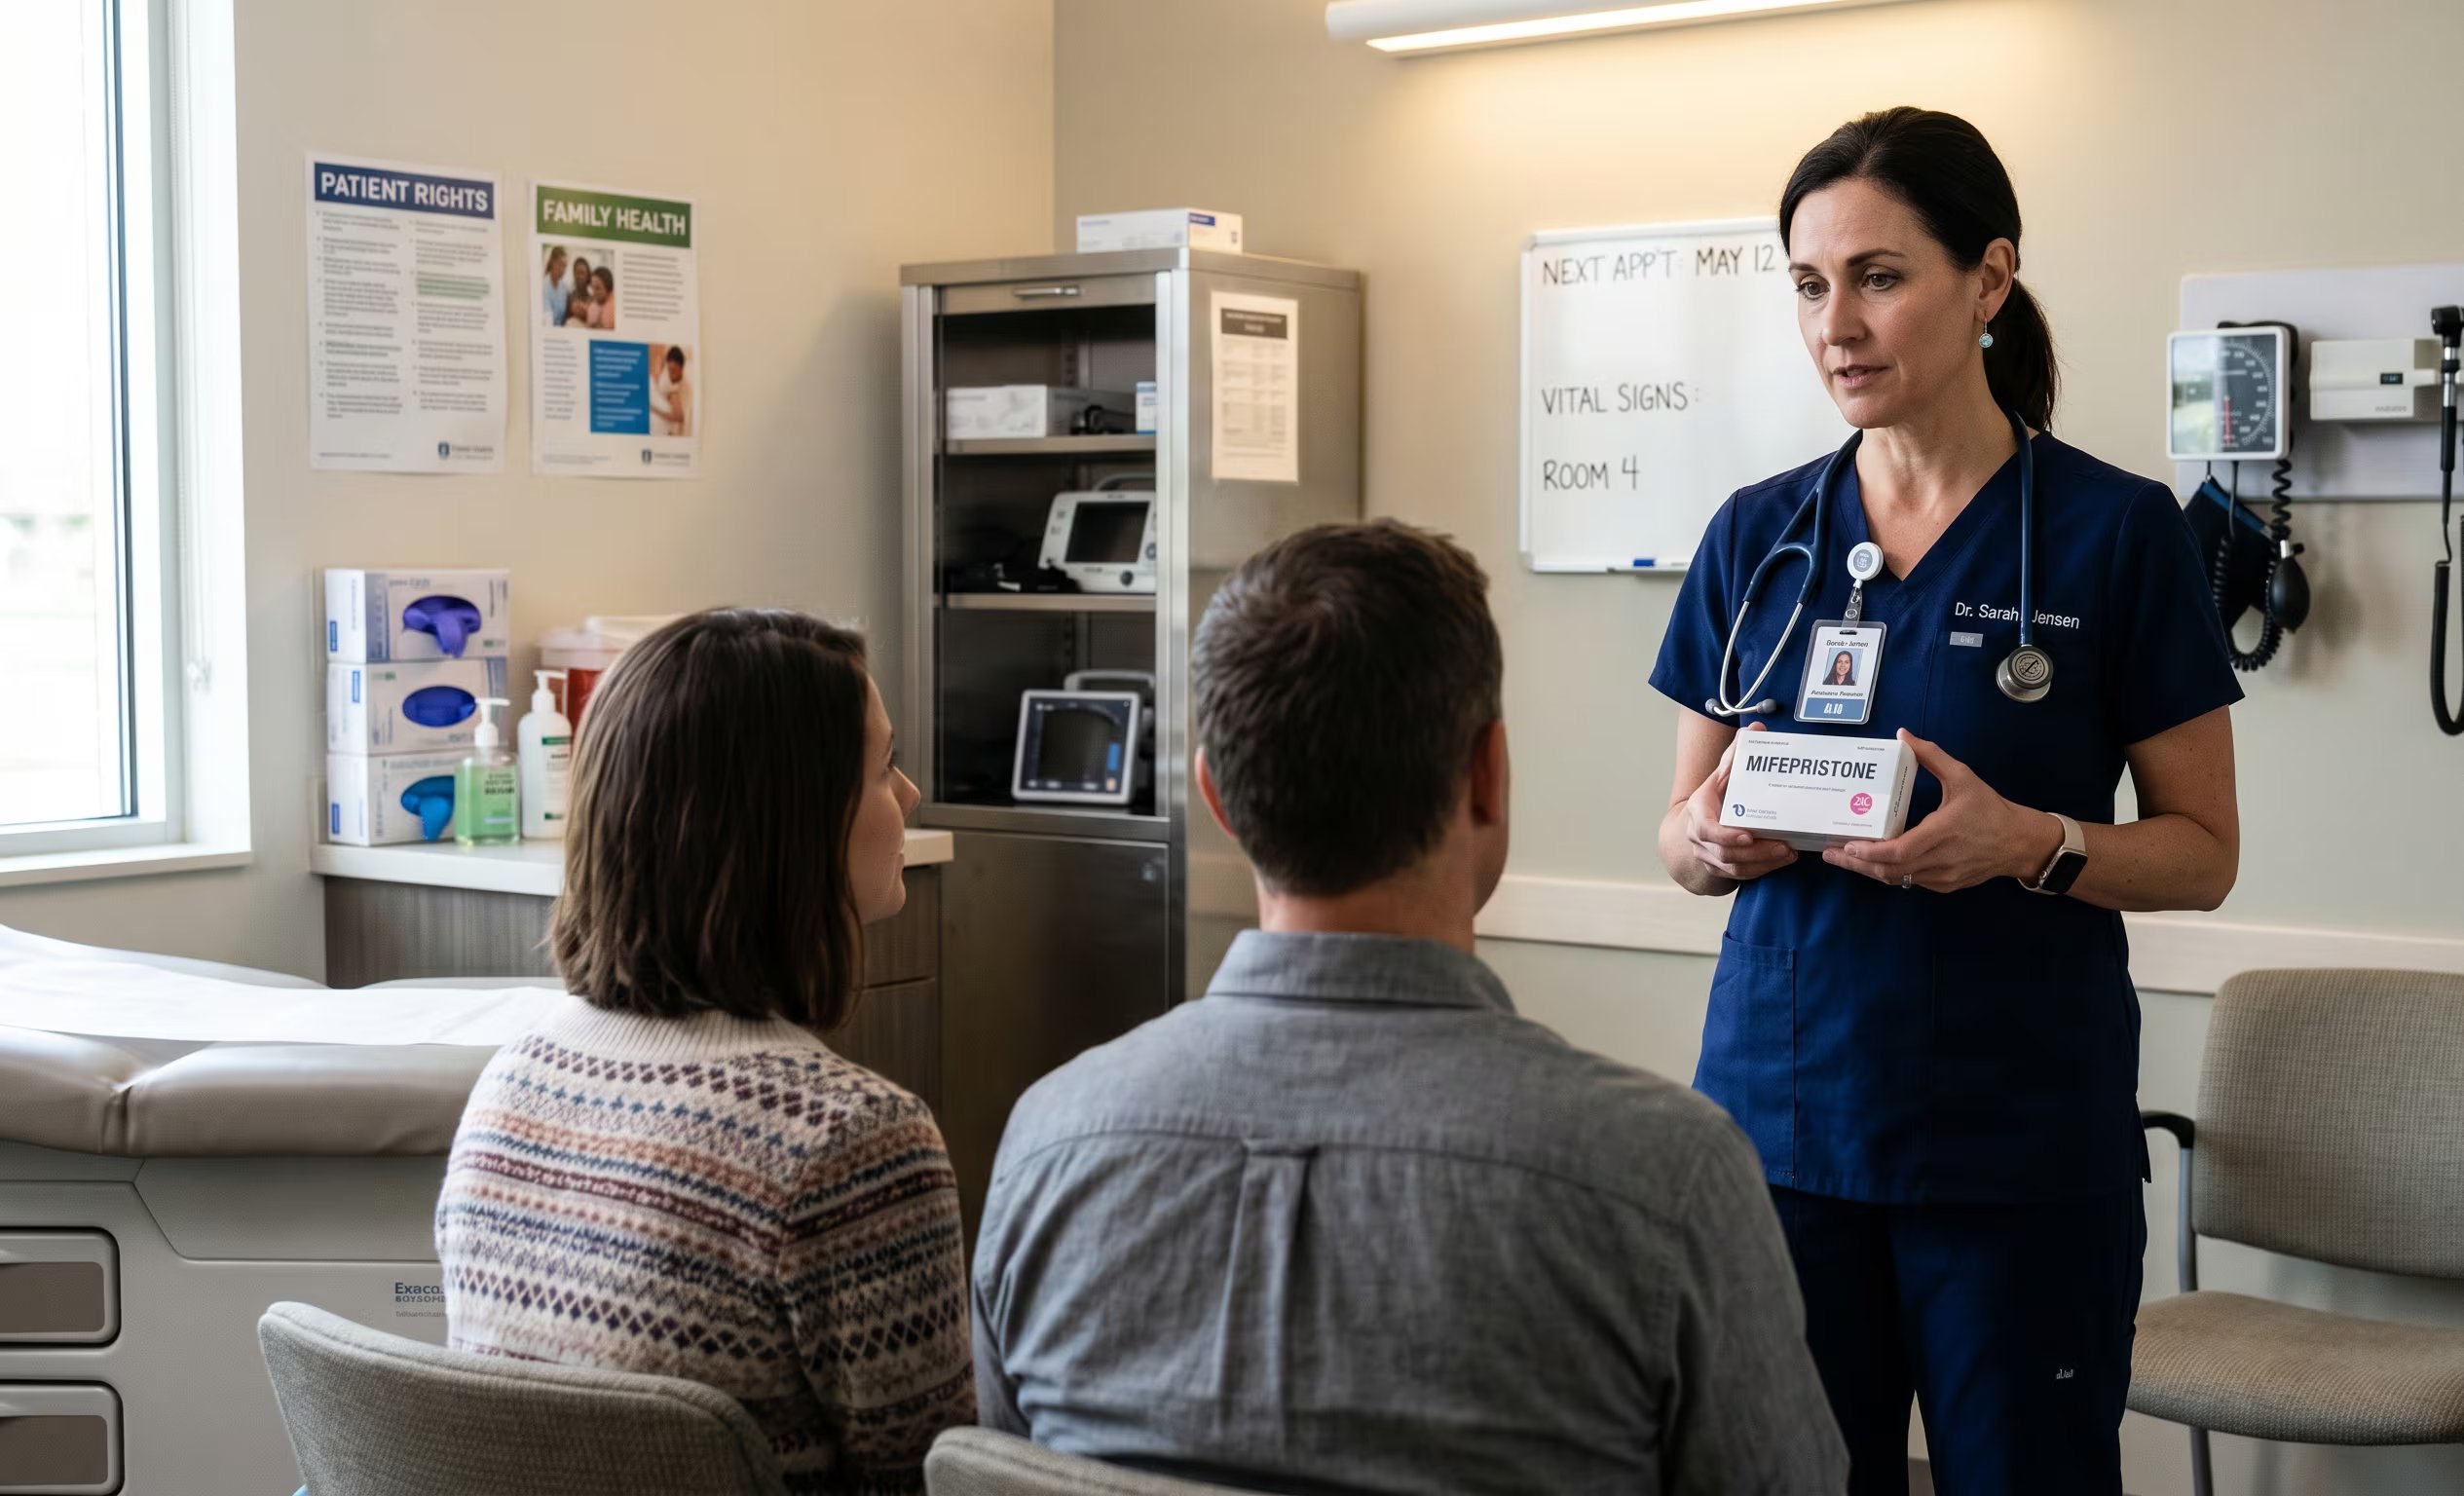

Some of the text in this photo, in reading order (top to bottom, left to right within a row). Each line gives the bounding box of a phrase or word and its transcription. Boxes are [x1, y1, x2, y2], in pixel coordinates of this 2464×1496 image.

[320, 171, 488, 211] PATIENT RIGHTS
[543, 200, 686, 235] FAMILY HEALTH
[1544, 255, 1605, 284] NEXT
[1696, 246, 1743, 276] MAY
[1754, 244, 1775, 273] 12
[1542, 388, 1607, 414] VITAL
[1544, 456, 1640, 490] ROOM 4
[1955, 602, 2080, 629] Dr. Sarah Jensen
[1746, 755, 1878, 779] MIFEPRISTONE
